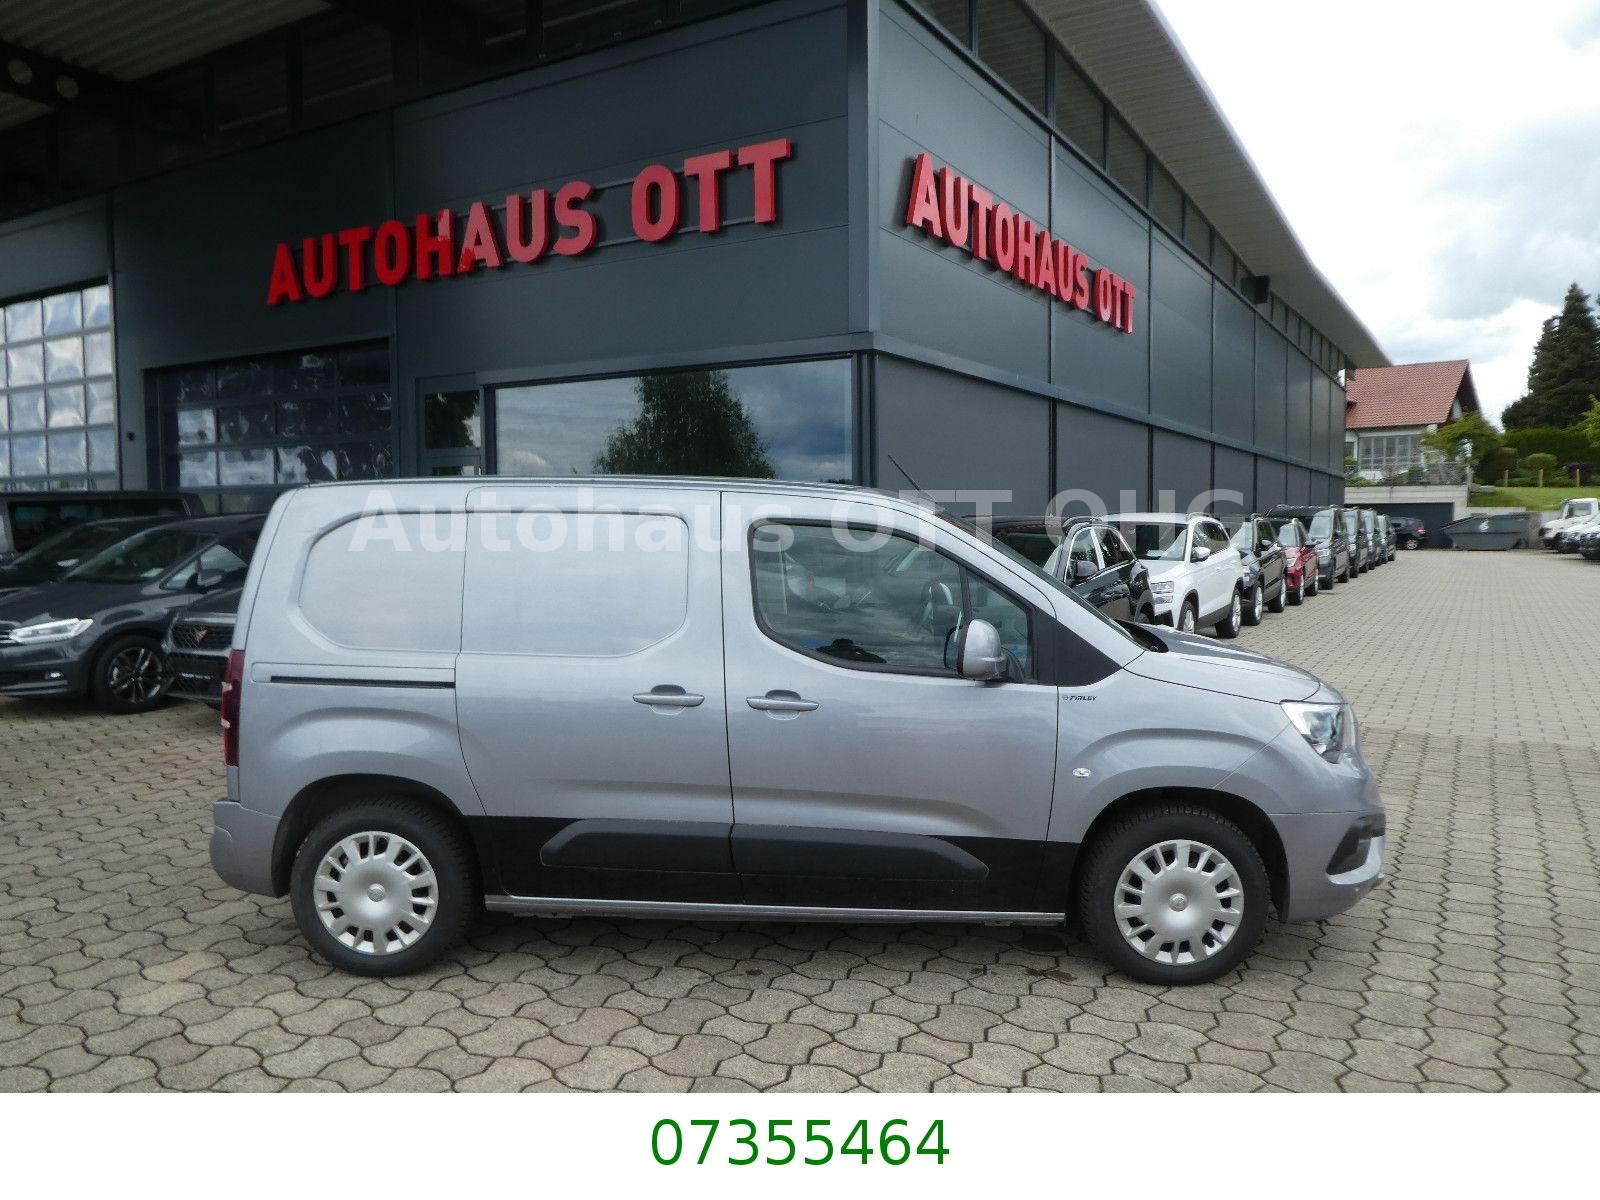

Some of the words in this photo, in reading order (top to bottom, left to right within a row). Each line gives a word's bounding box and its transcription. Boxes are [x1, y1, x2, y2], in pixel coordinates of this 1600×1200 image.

[267, 180, 597, 305] AUTOHAUS
[630, 138, 791, 242] OTT
[906, 152, 1089, 310] AUTOHAUS
[1095, 265, 1137, 334] OTT
